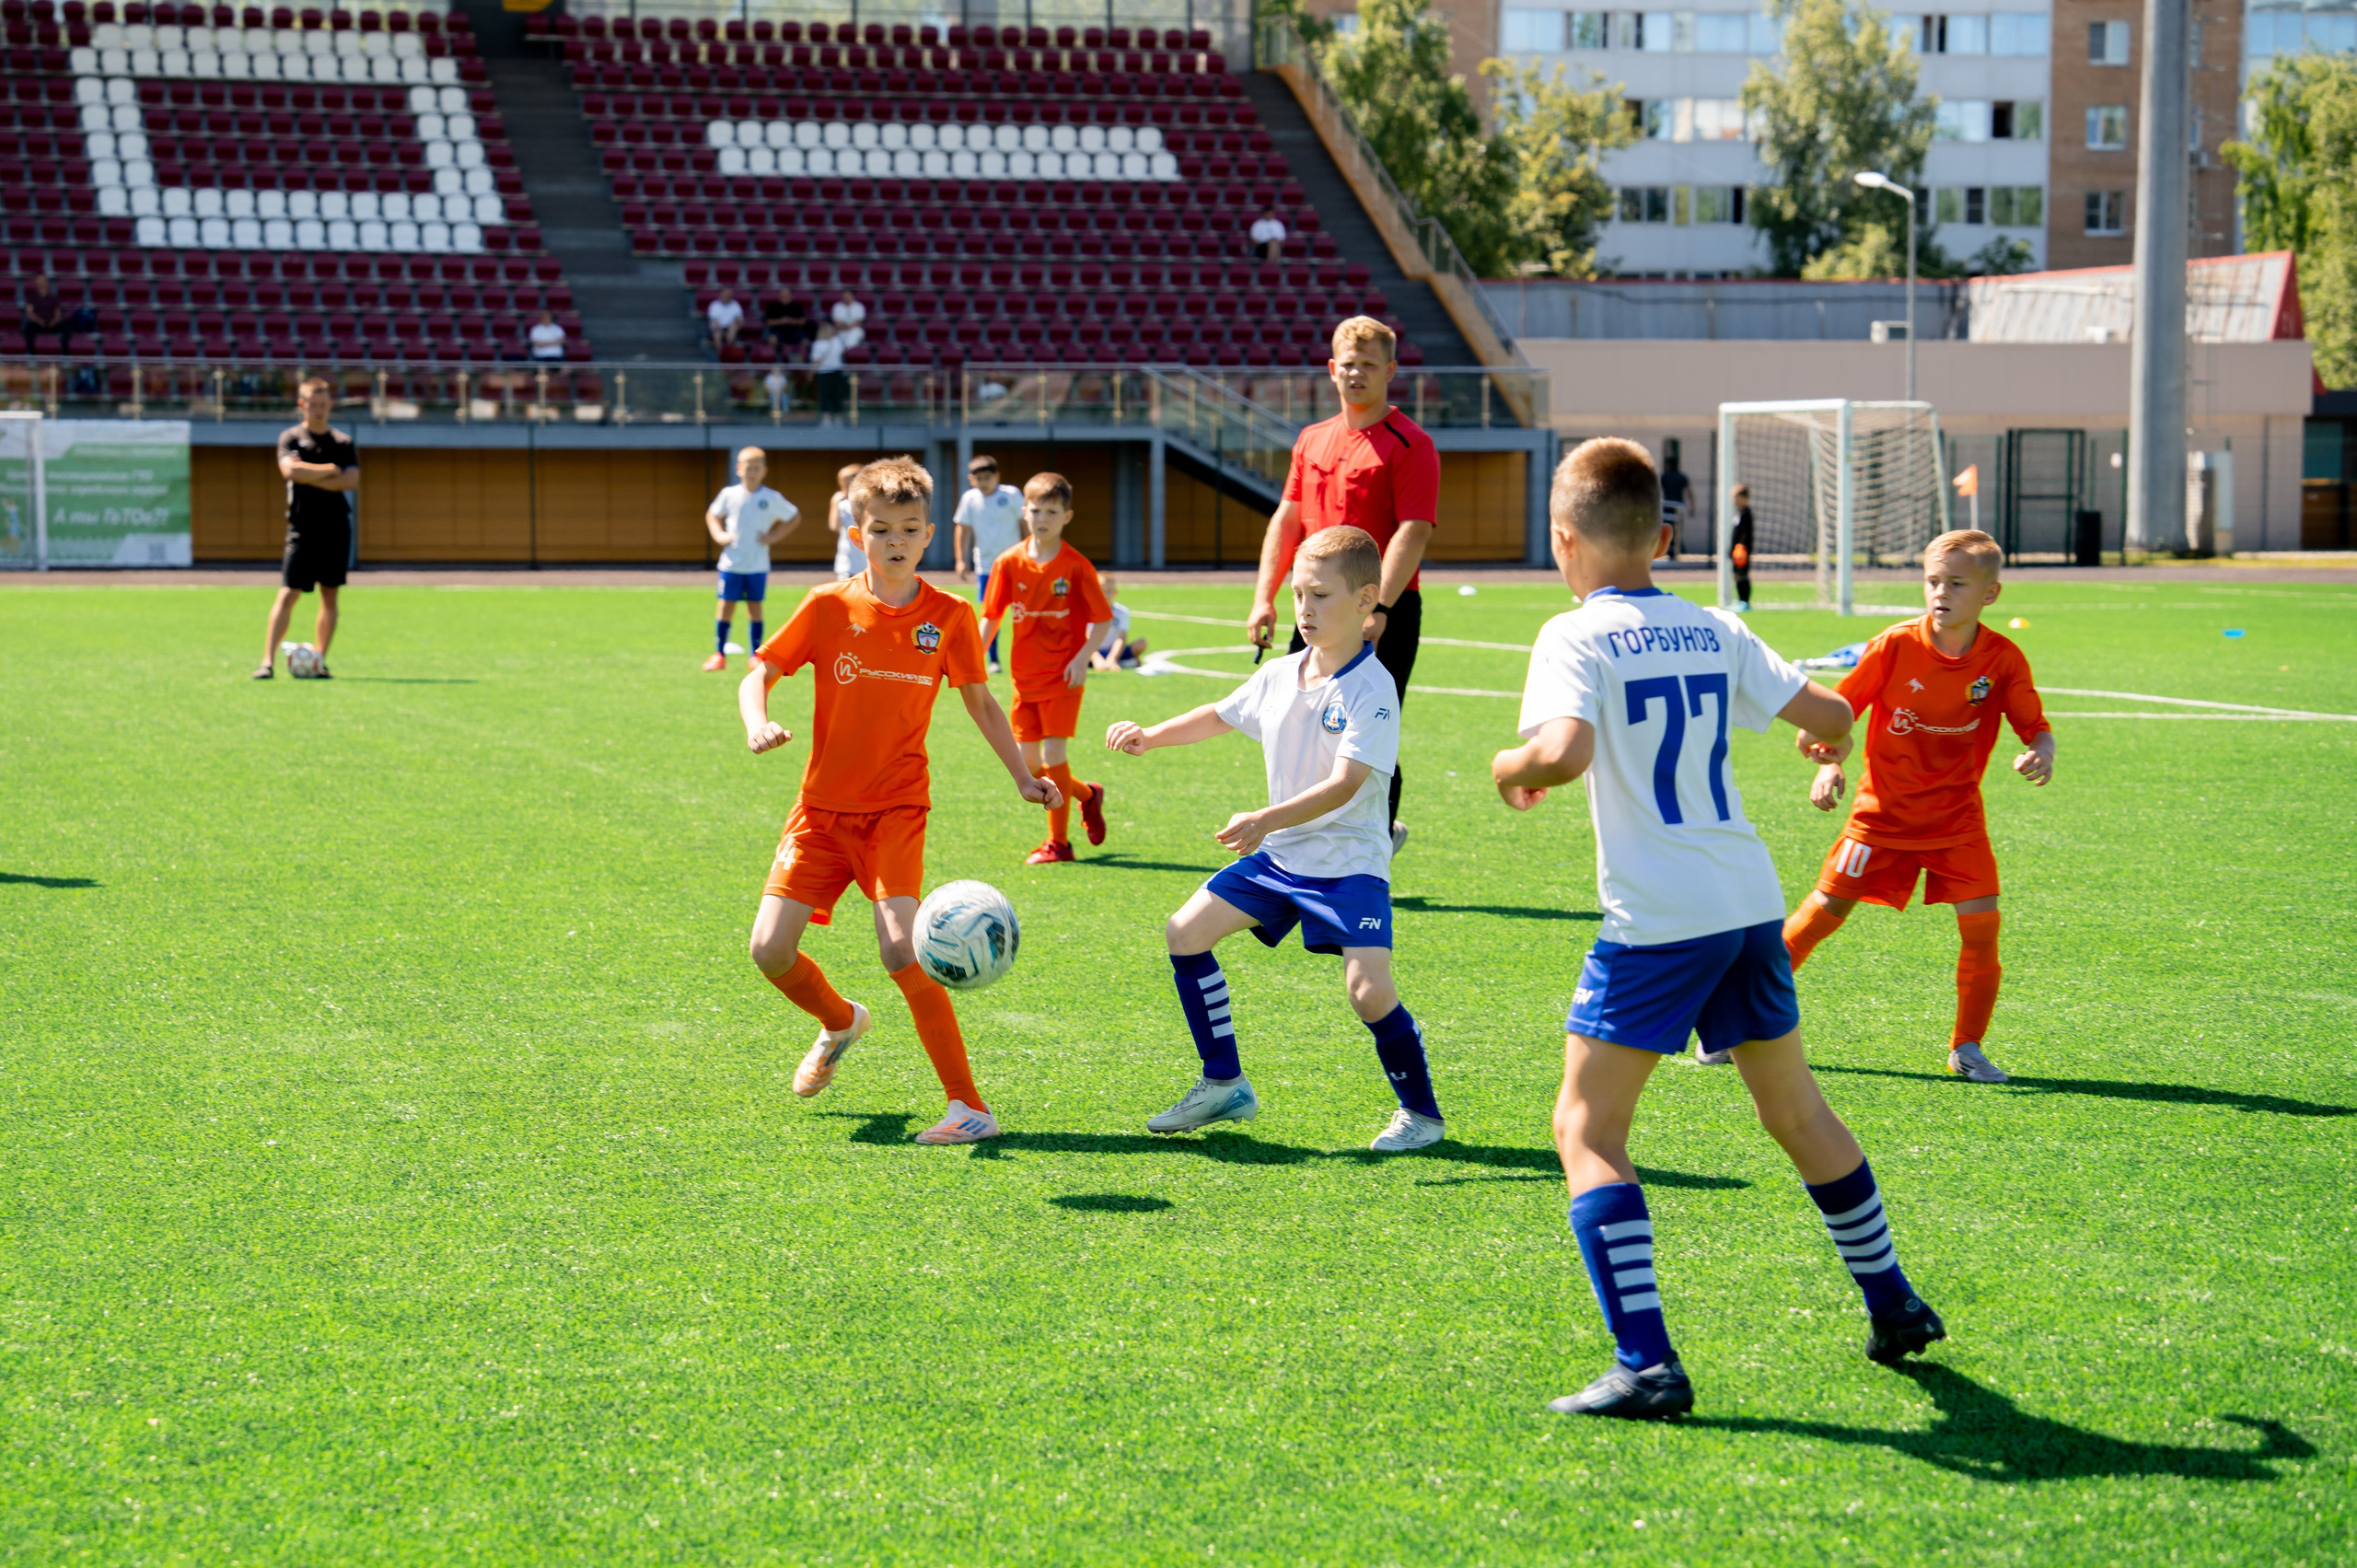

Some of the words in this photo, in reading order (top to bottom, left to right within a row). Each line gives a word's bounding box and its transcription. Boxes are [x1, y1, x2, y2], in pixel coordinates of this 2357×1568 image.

[1608, 624, 1720, 657] ГОРБУНОВ
[1624, 672, 1731, 825] 77
[1835, 839, 1873, 878] 10
[1358, 917, 1382, 930] FN
